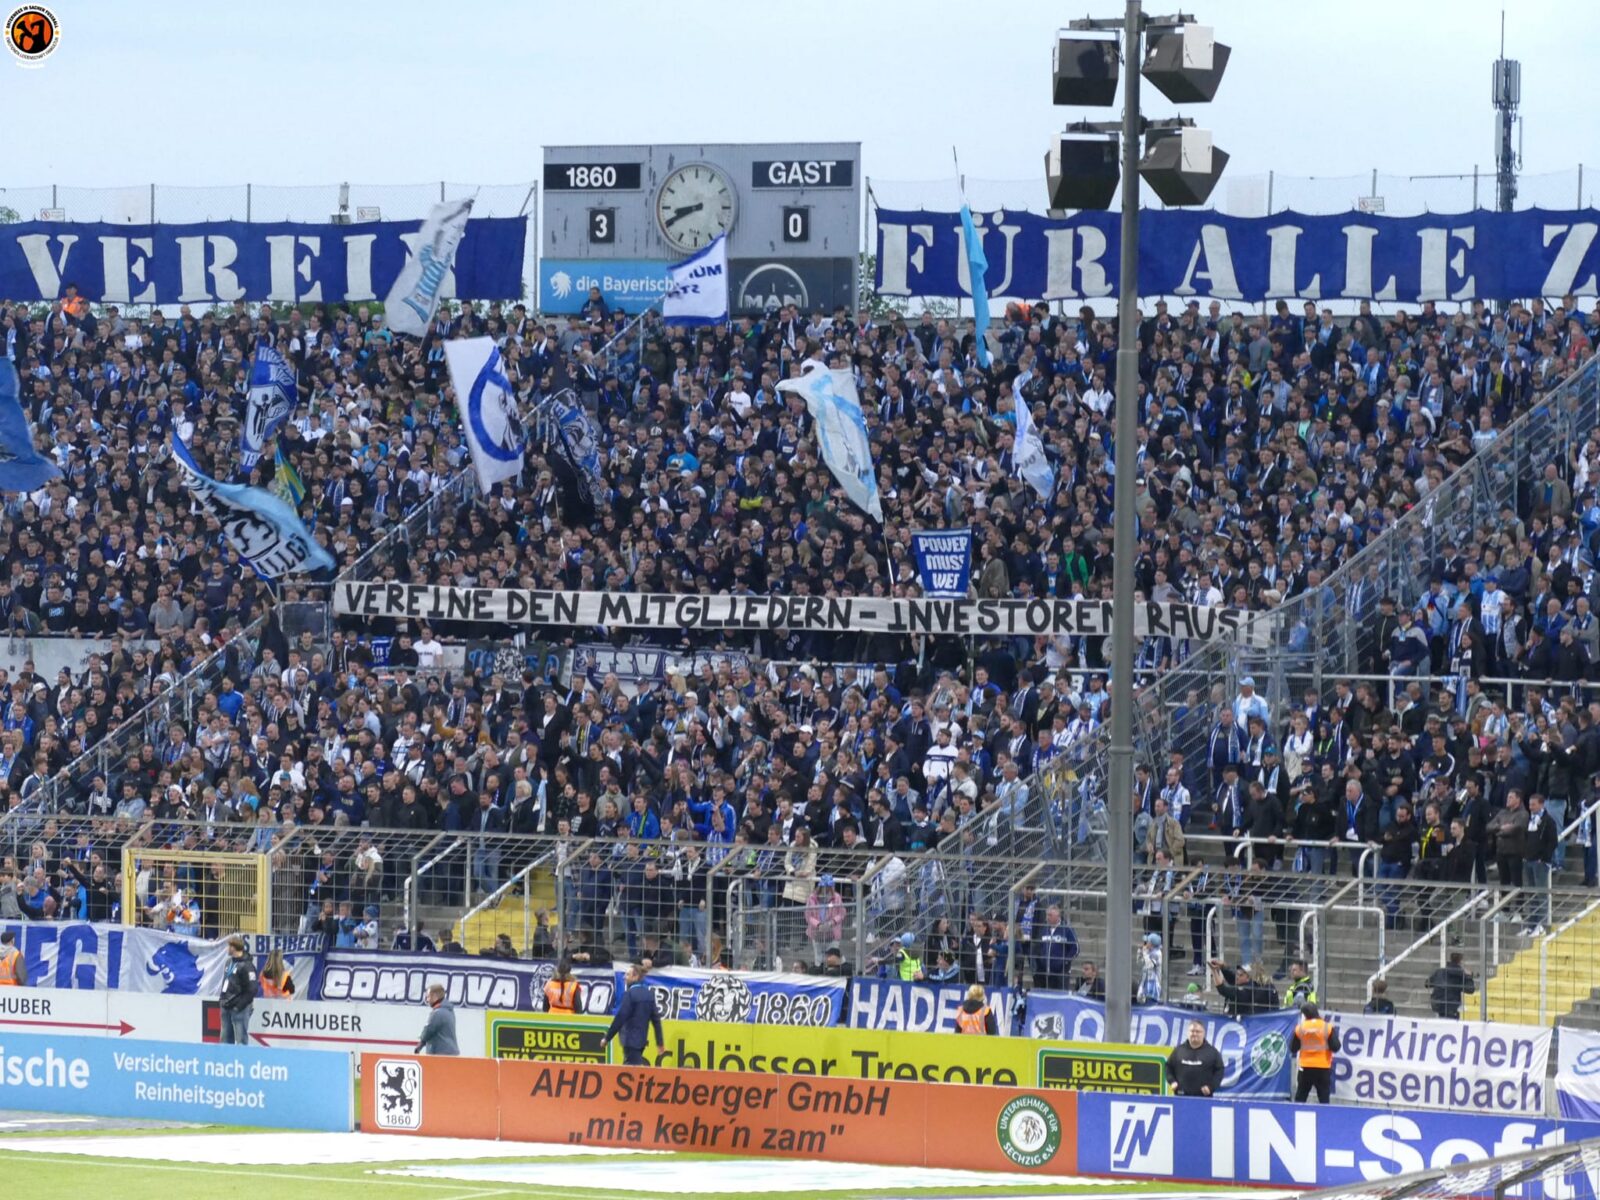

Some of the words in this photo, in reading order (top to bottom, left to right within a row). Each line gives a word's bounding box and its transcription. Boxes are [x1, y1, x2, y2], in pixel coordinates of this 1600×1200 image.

[566, 167, 617, 188] 1860
[768, 162, 836, 185] GAST
[595, 213, 607, 238] 3
[788, 213, 802, 238] 0
[877, 211, 1113, 300] FÜR
[1174, 224, 1476, 301] ALLE
[576, 276, 599, 292] die
[603, 276, 674, 294] Bayerisch
[744, 294, 802, 313] MAN
[345, 583, 494, 619] VEREINE
[506, 591, 580, 625] DEN
[600, 593, 851, 632] MITGLIEDERN
[1146, 602, 1255, 646] RAUS!
[595, 651, 659, 675] TSV
[256, 933, 323, 953] BLEIBEN!
[261, 1010, 362, 1032] SAMHUBER
[753, 992, 831, 1026] 1860
[850, 982, 1016, 1037] HADEN
[523, 1030, 581, 1050] BURG
[1323, 1013, 1533, 1068] ierkirchen
[113, 1052, 201, 1077] Versichert
[204, 1058, 245, 1079] nach
[250, 1061, 288, 1082] dem
[851, 1050, 1018, 1088] Tresore
[1071, 1060, 1133, 1081] BURG
[135, 1081, 266, 1109] Reinheitsgebot
[530, 1068, 603, 1099] AHD
[613, 1071, 777, 1116] Sitzberger
[787, 1081, 891, 1116] GmbH
[1330, 1056, 1543, 1111] Pasenbach
[386, 1114, 412, 1126] 1860
[1000, 1097, 1050, 1130] UNTERNEHMER
[1046, 1113, 1058, 1133] FÜR
[1003, 1142, 1042, 1166] SECHZIG
